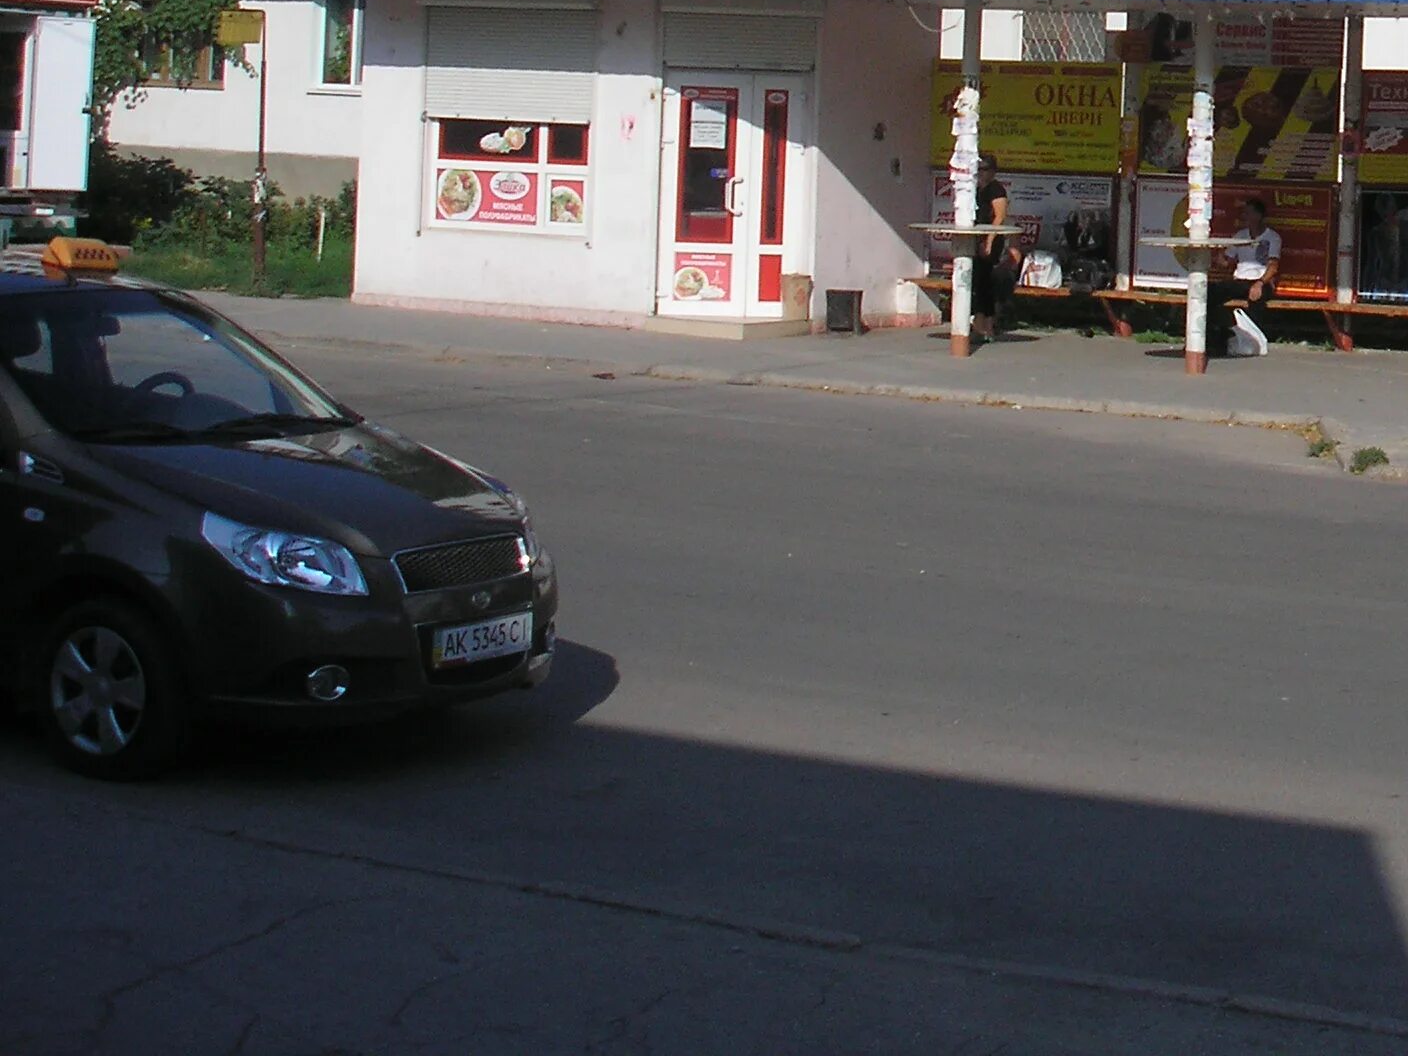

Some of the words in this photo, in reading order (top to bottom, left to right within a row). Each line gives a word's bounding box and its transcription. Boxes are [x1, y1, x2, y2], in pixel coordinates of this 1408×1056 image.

[1034, 82, 1117, 108] ОКНА
[1045, 110, 1103, 126] ДВЕРИ
[443, 628, 468, 657] AK
[471, 623, 507, 651] 5345
